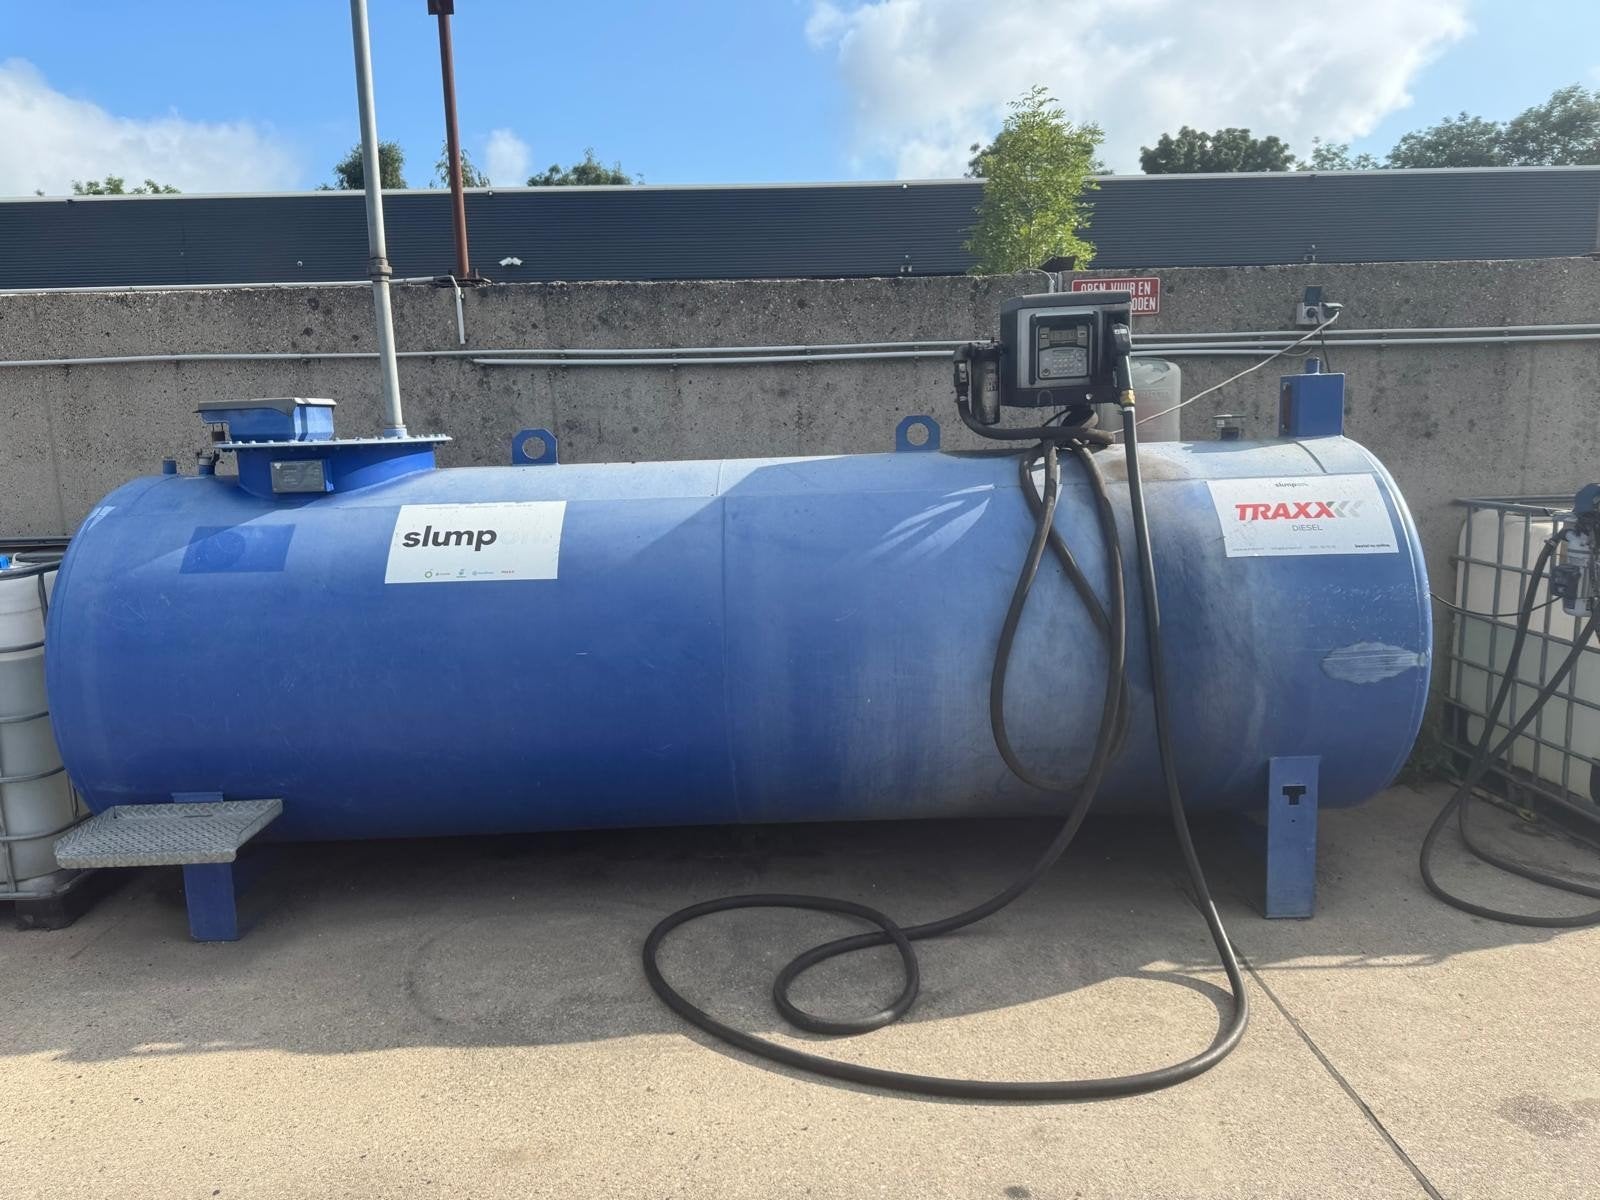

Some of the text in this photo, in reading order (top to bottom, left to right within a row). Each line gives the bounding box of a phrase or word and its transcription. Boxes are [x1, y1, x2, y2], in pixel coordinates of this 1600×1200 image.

[1138, 281, 1151, 295] EN
[1131, 296, 1156, 311] ODEN
[1235, 501, 1336, 521] TRAXX
[1292, 523, 1324, 532] DIESEL
